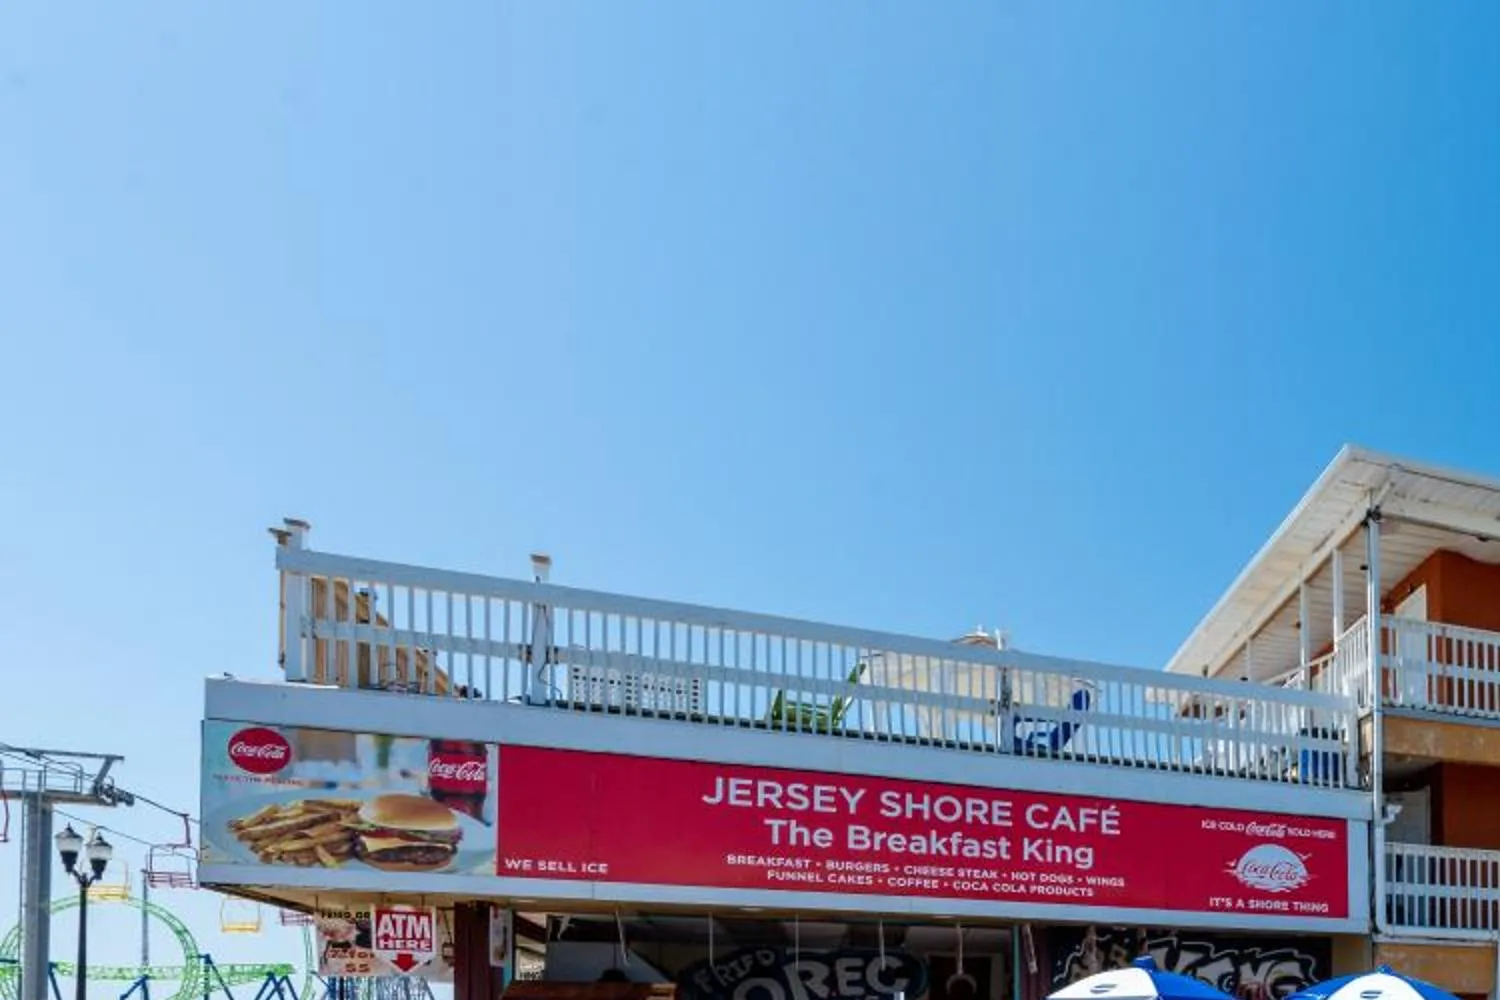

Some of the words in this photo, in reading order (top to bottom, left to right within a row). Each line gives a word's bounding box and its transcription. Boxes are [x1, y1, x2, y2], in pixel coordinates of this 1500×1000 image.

[231, 740, 289, 759] Coca-Cola
[429, 758, 487, 781] Coca-Cola
[702, 776, 866, 815] JERSEY
[879, 790, 1013, 828] SHORE
[1025, 803, 1121, 835] CAFÉ
[763, 818, 834, 848] The
[847, 824, 1011, 860] Breakfast
[1023, 837, 1094, 870] King
[504, 858, 533, 870] WE
[538, 859, 577, 873] SELL
[581, 863, 609, 875] ICE
[727, 853, 811, 869] BREAKFAST
[825, 860, 891, 873] BURGERS
[903, 864, 955, 877] CHEESE
[957, 868, 999, 880] STEAK
[1011, 871, 1036, 881] HOT
[1039, 874, 1075, 885] DOGS
[1085, 876, 1126, 888] WINGS
[767, 869, 824, 883] FUNNEL
[827, 873, 873, 886] CAKES
[887, 877, 939, 889] COFFEE
[953, 880, 989, 892] COCA
[992, 883, 1026, 893] COLA
[1029, 885, 1094, 897] PRODUCTS
[1209, 896, 1233, 908] IT'S
[1235, 898, 1245, 909] A
[1248, 899, 1290, 911] SHORE
[1293, 901, 1329, 913] THING
[377, 913, 432, 939] ATM
[379, 939, 432, 950] HERE
